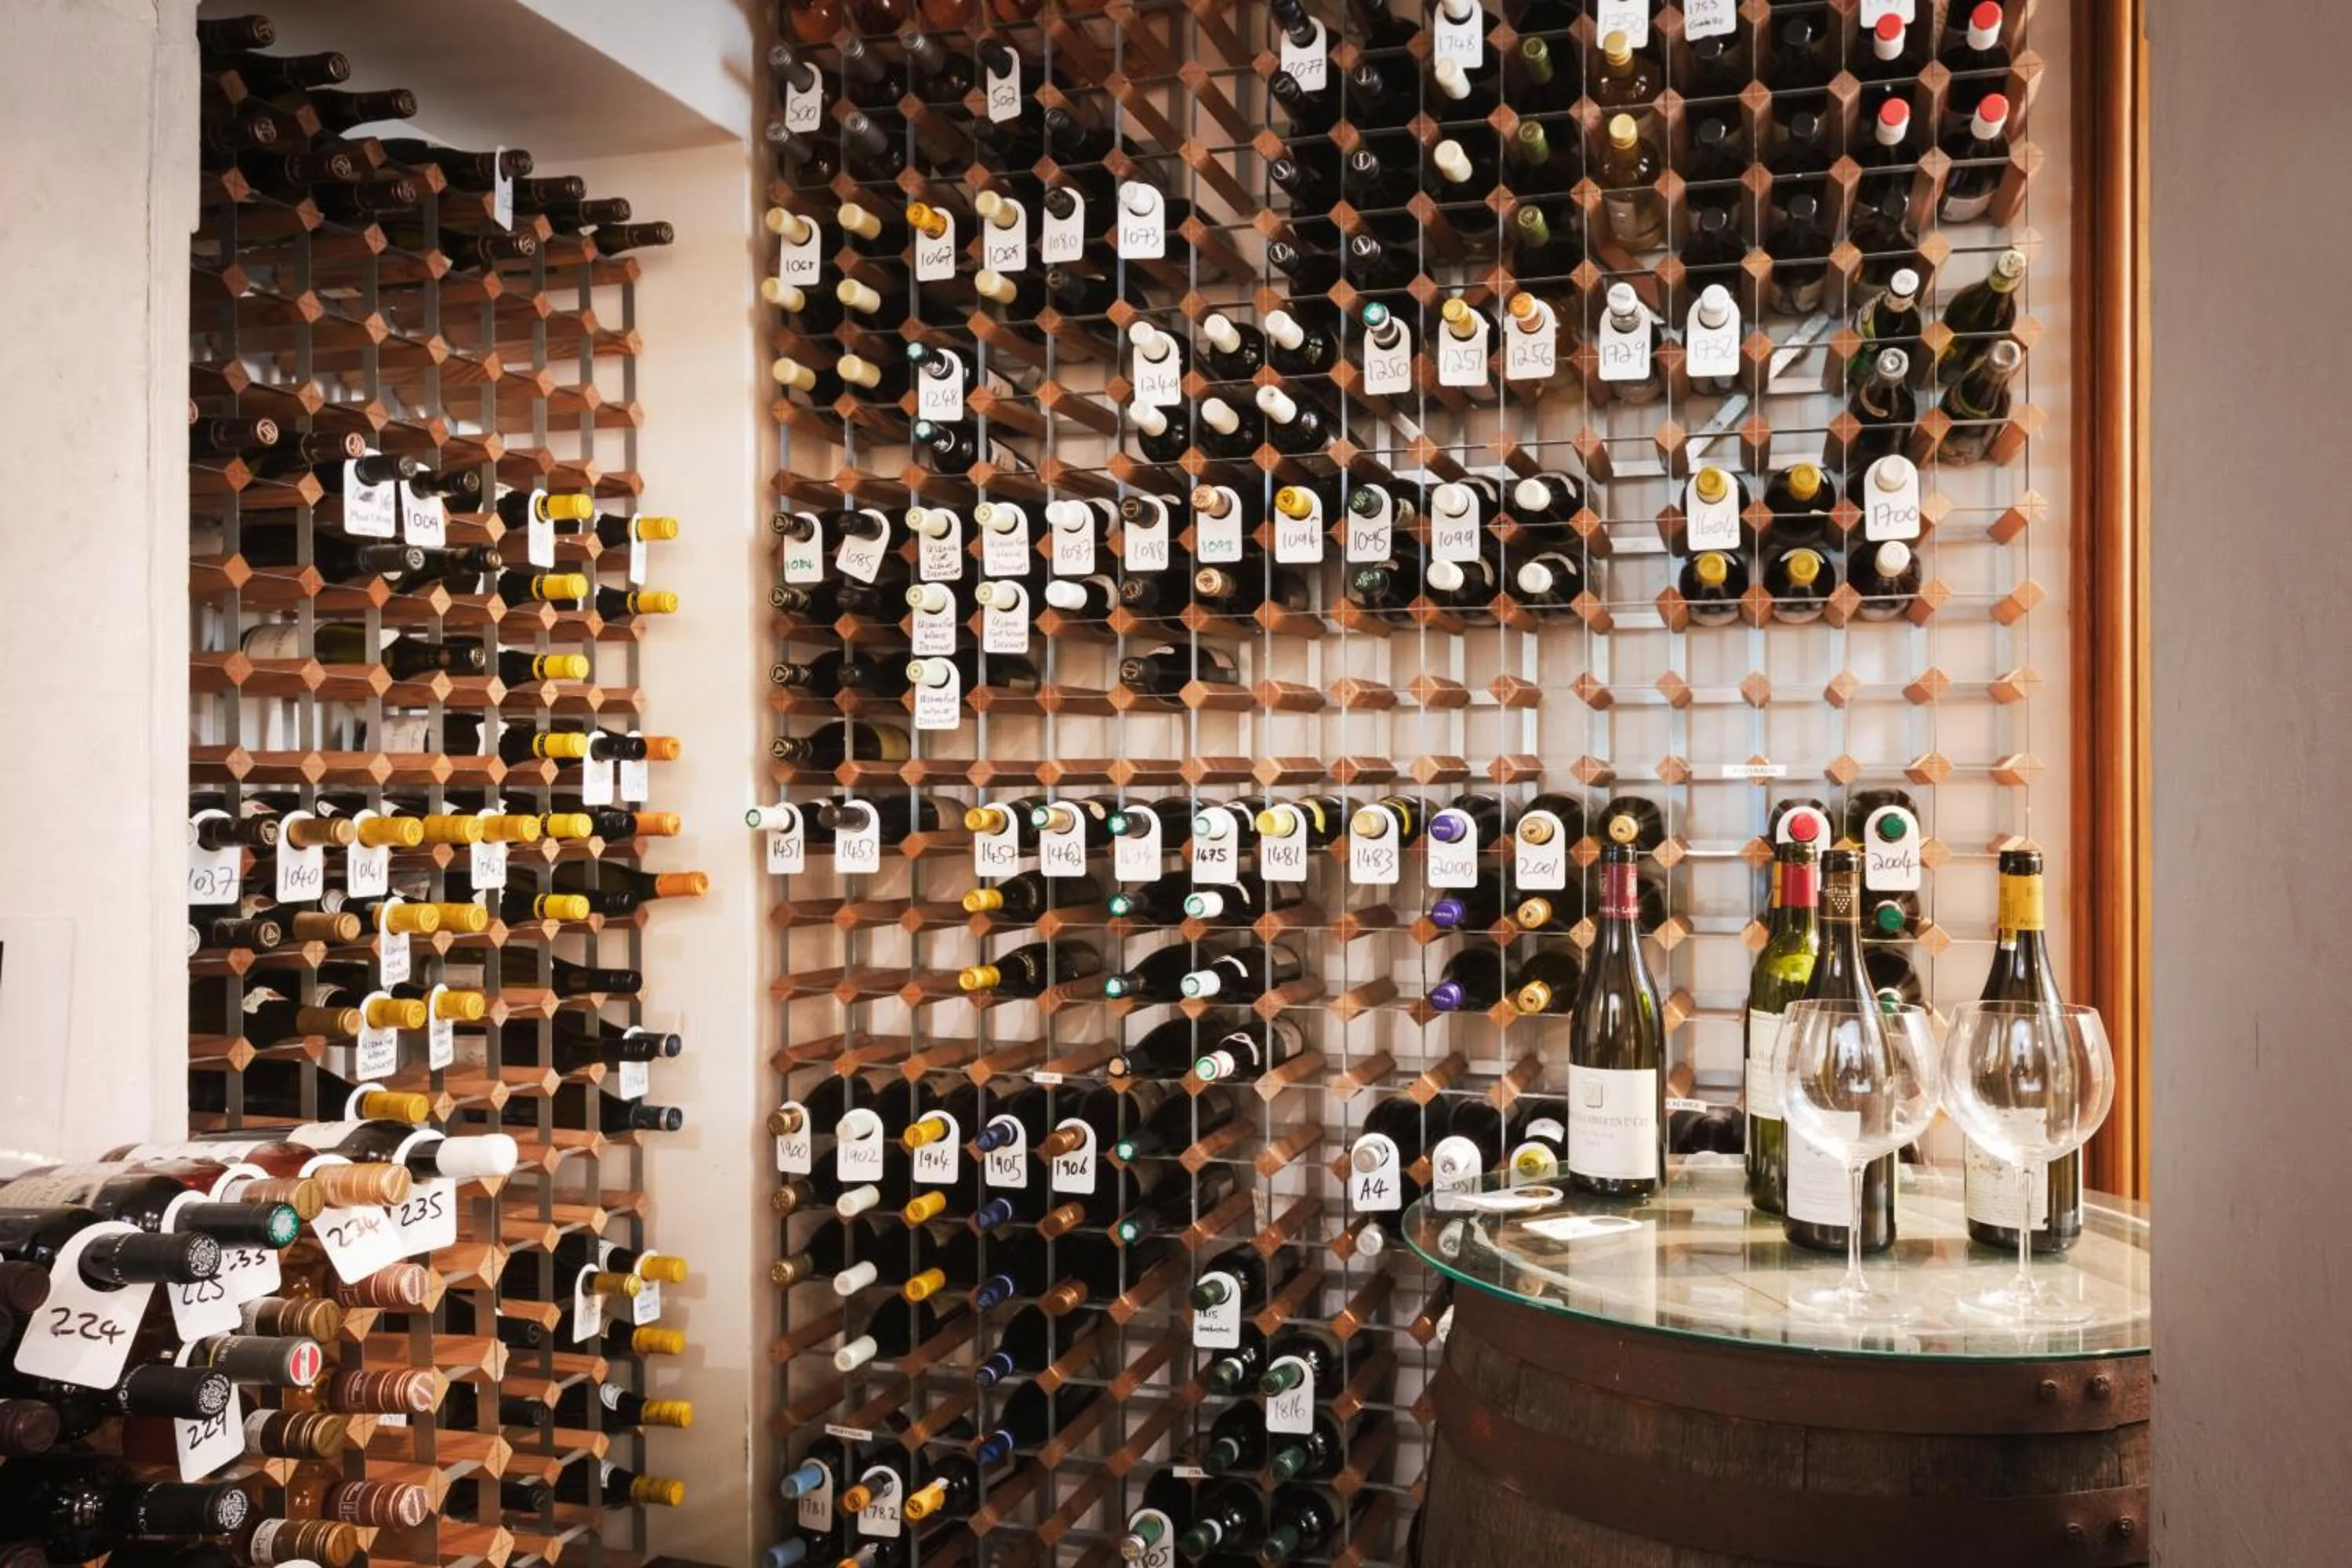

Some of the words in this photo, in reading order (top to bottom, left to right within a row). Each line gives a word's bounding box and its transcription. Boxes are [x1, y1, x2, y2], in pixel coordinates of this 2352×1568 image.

[1439, 34, 1475, 53] 1748
[788, 96, 816, 122] 500
[992, 85, 1017, 110] 502
[1049, 233, 1078, 251] 1080
[1123, 227, 1160, 249] 1073
[1512, 342, 1553, 367] 1256
[1603, 341, 1646, 368] 1729
[1369, 356, 1408, 382] 1250
[925, 389, 958, 407] 1248
[407, 507, 438, 532] 1009
[1874, 503, 1918, 528] 1700
[1134, 539, 1166, 561] 1088
[1354, 526, 1388, 552] 1095
[1439, 530, 1475, 548] 1099
[774, 837, 800, 859] 1451
[843, 838, 874, 862] 1453
[1196, 848, 1228, 862] 1475
[1268, 846, 1300, 866] 1481
[1356, 848, 1394, 877] 1483
[1431, 855, 1473, 878] 2000
[1519, 856, 1559, 876] 2001
[1871, 851, 1918, 877] 2004
[188, 866, 238, 896] 1037
[284, 865, 319, 891] 1040
[844, 1145, 879, 1164] 1902
[919, 1149, 950, 1171] 1904
[989, 1152, 1022, 1181] 1905
[1055, 1156, 1088, 1176] 1906
[1360, 1178, 1389, 1201] A4
[401, 1191, 444, 1227] 235
[326, 1216, 381, 1247] 234
[51, 1307, 125, 1345] 224
[1275, 1395, 1305, 1421] 1816
[800, 1498, 825, 1517] 1781
[864, 1504, 898, 1520] 1782
